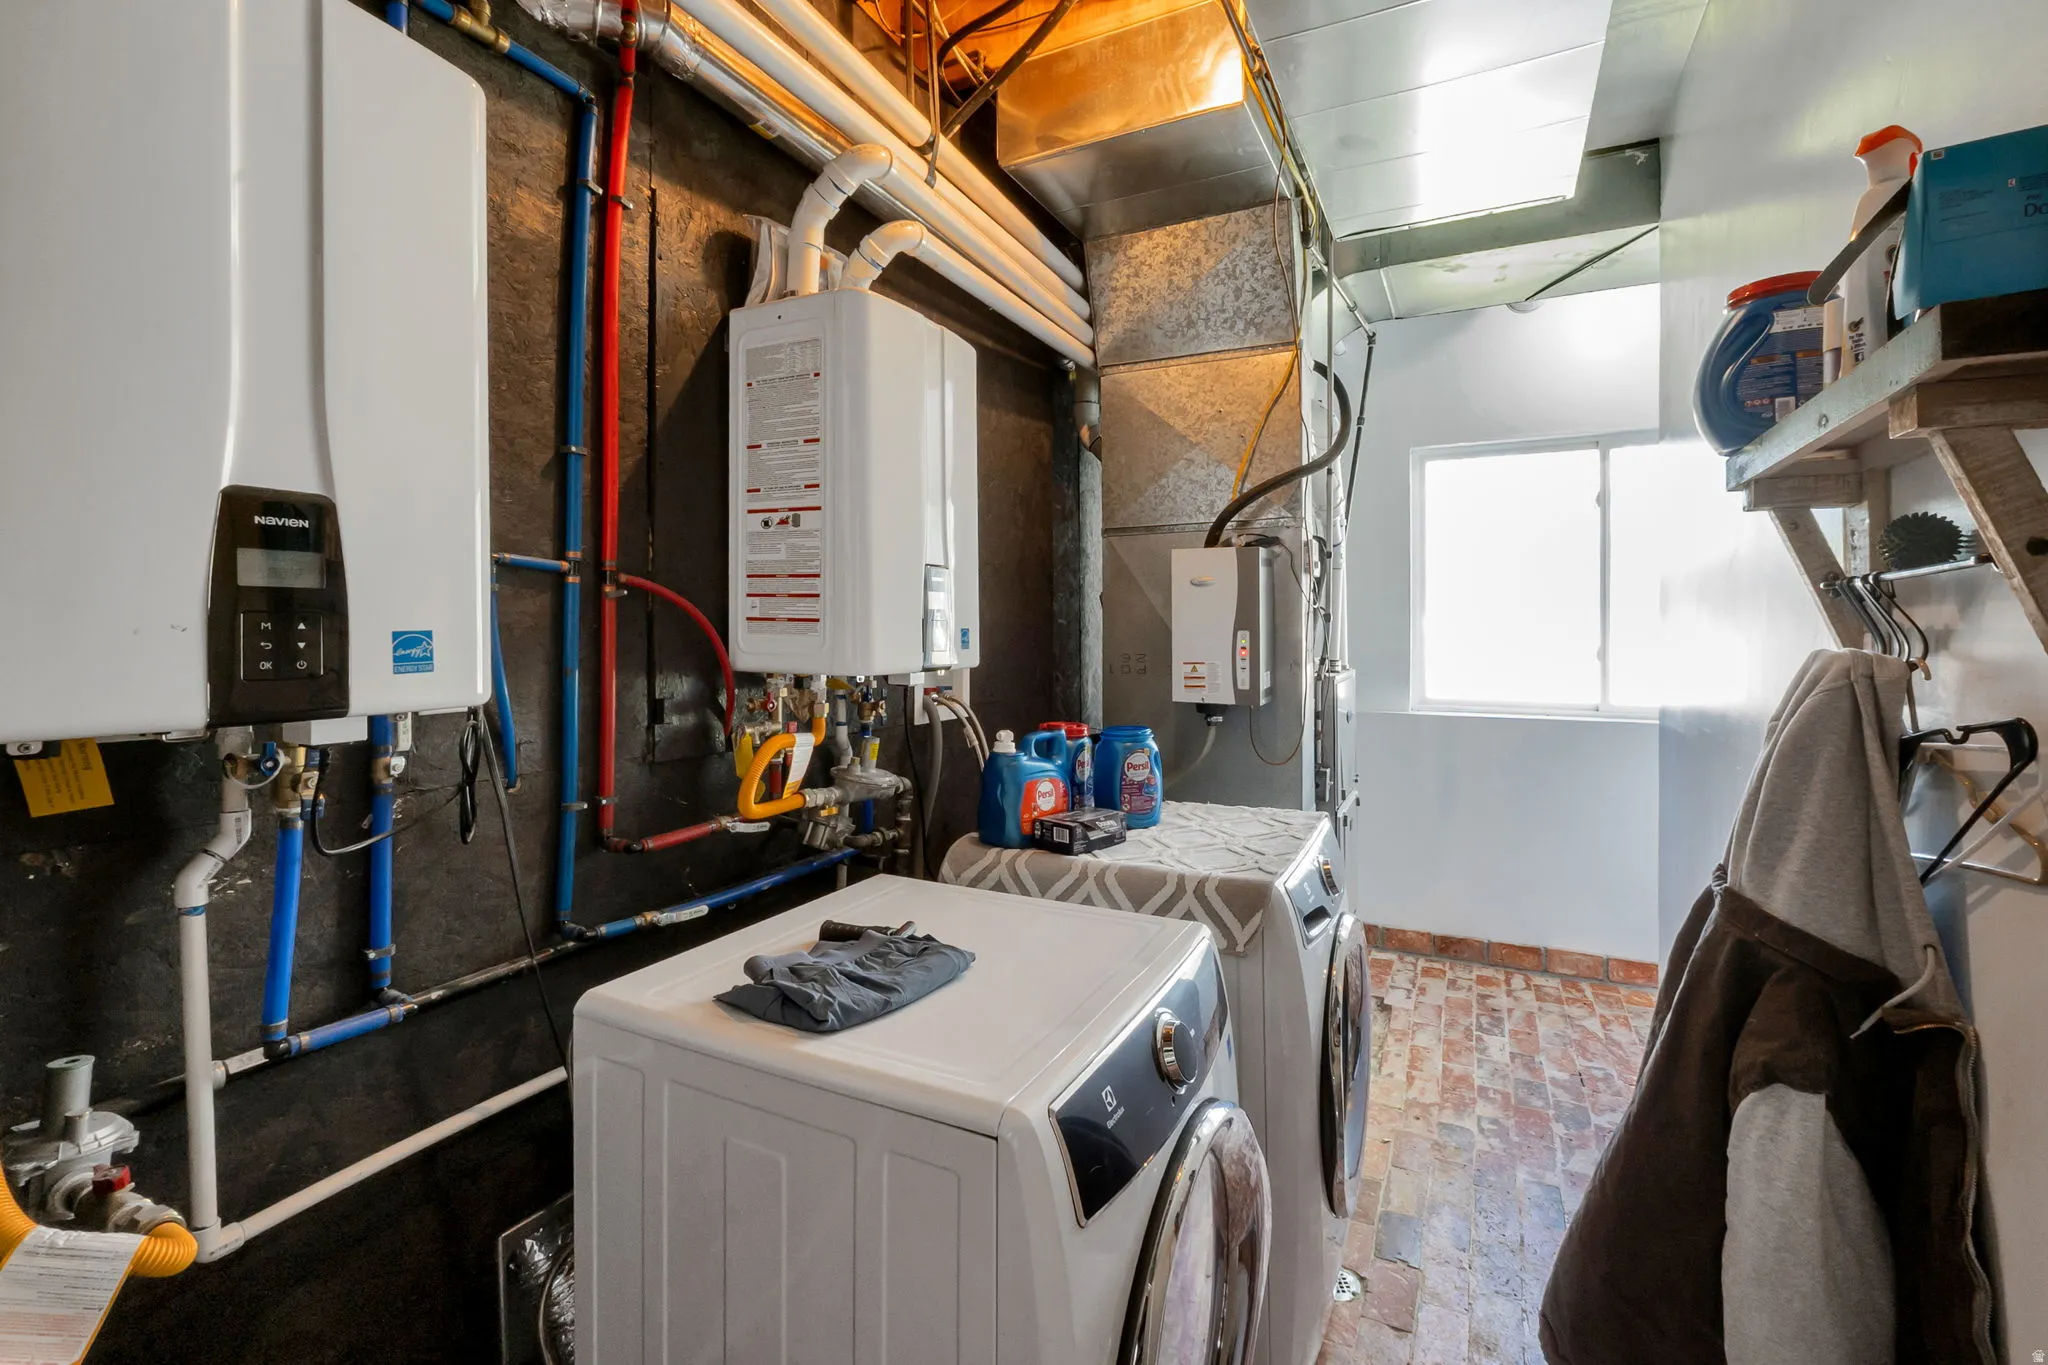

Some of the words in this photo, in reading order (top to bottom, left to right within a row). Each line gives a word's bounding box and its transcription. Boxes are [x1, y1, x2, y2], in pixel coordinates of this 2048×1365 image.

[261, 622, 272, 630] M
[260, 661, 273, 670] OK
[1126, 761, 1150, 773] Persil
[1037, 788, 1054, 800] Persil
